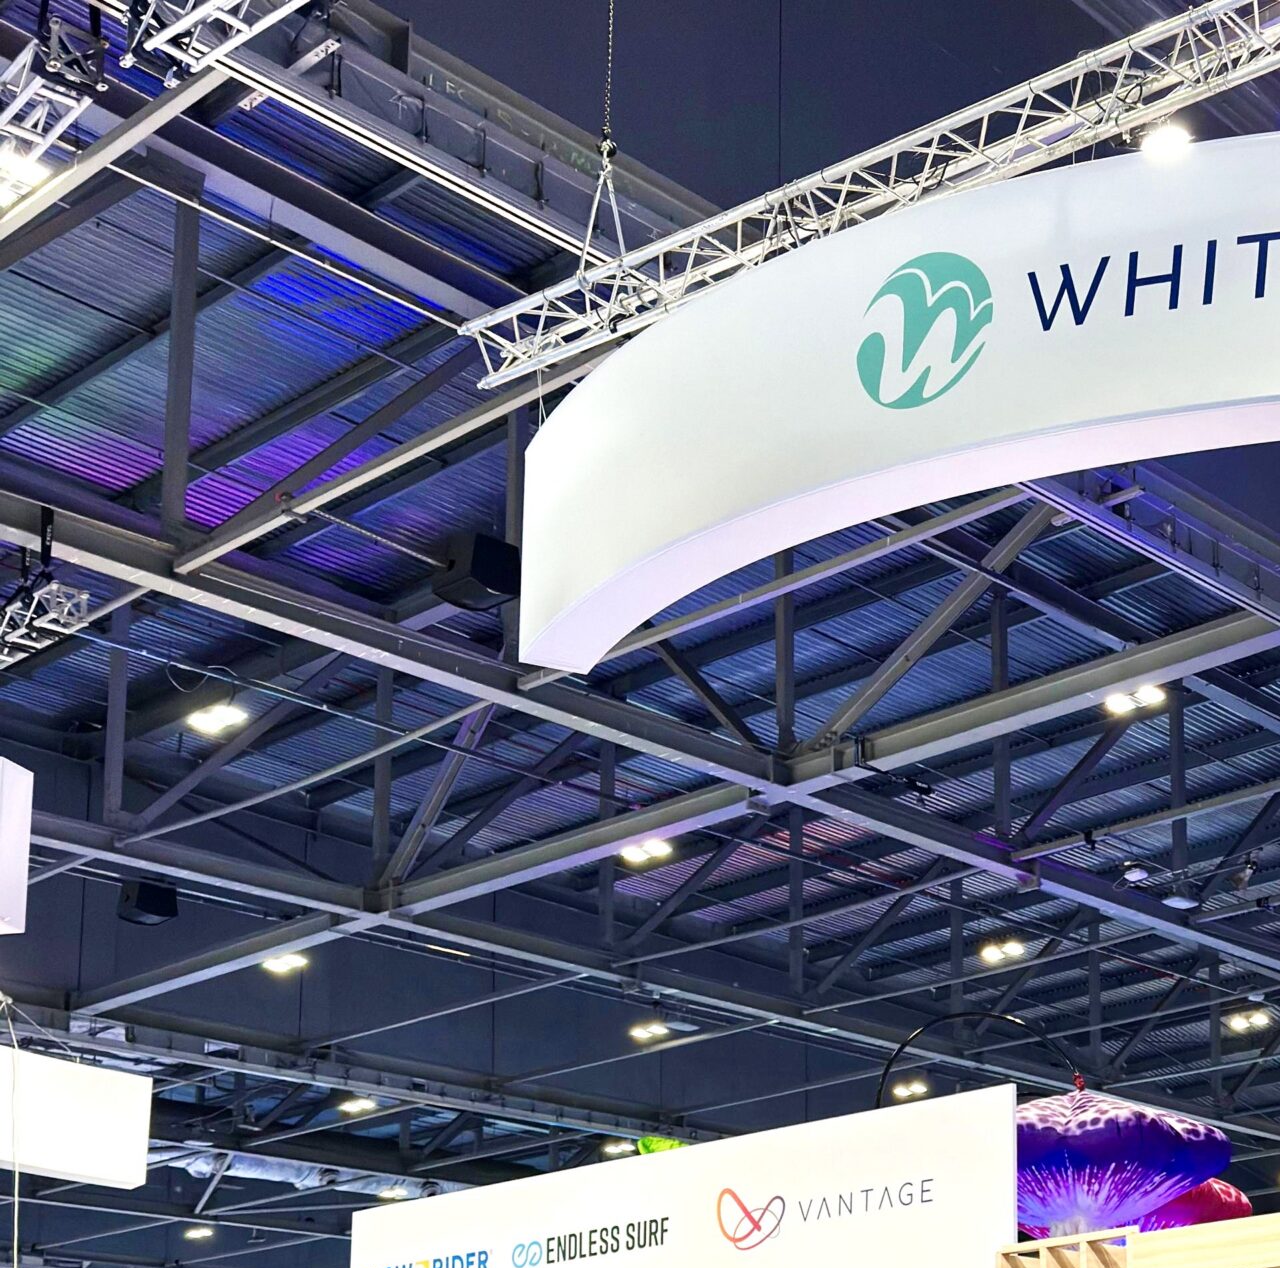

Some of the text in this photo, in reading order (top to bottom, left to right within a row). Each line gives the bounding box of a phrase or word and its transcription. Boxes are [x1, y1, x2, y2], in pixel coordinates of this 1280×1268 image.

[798, 1178, 935, 1222] VANTAGE
[546, 1216, 670, 1265] ENDLESS SURF
